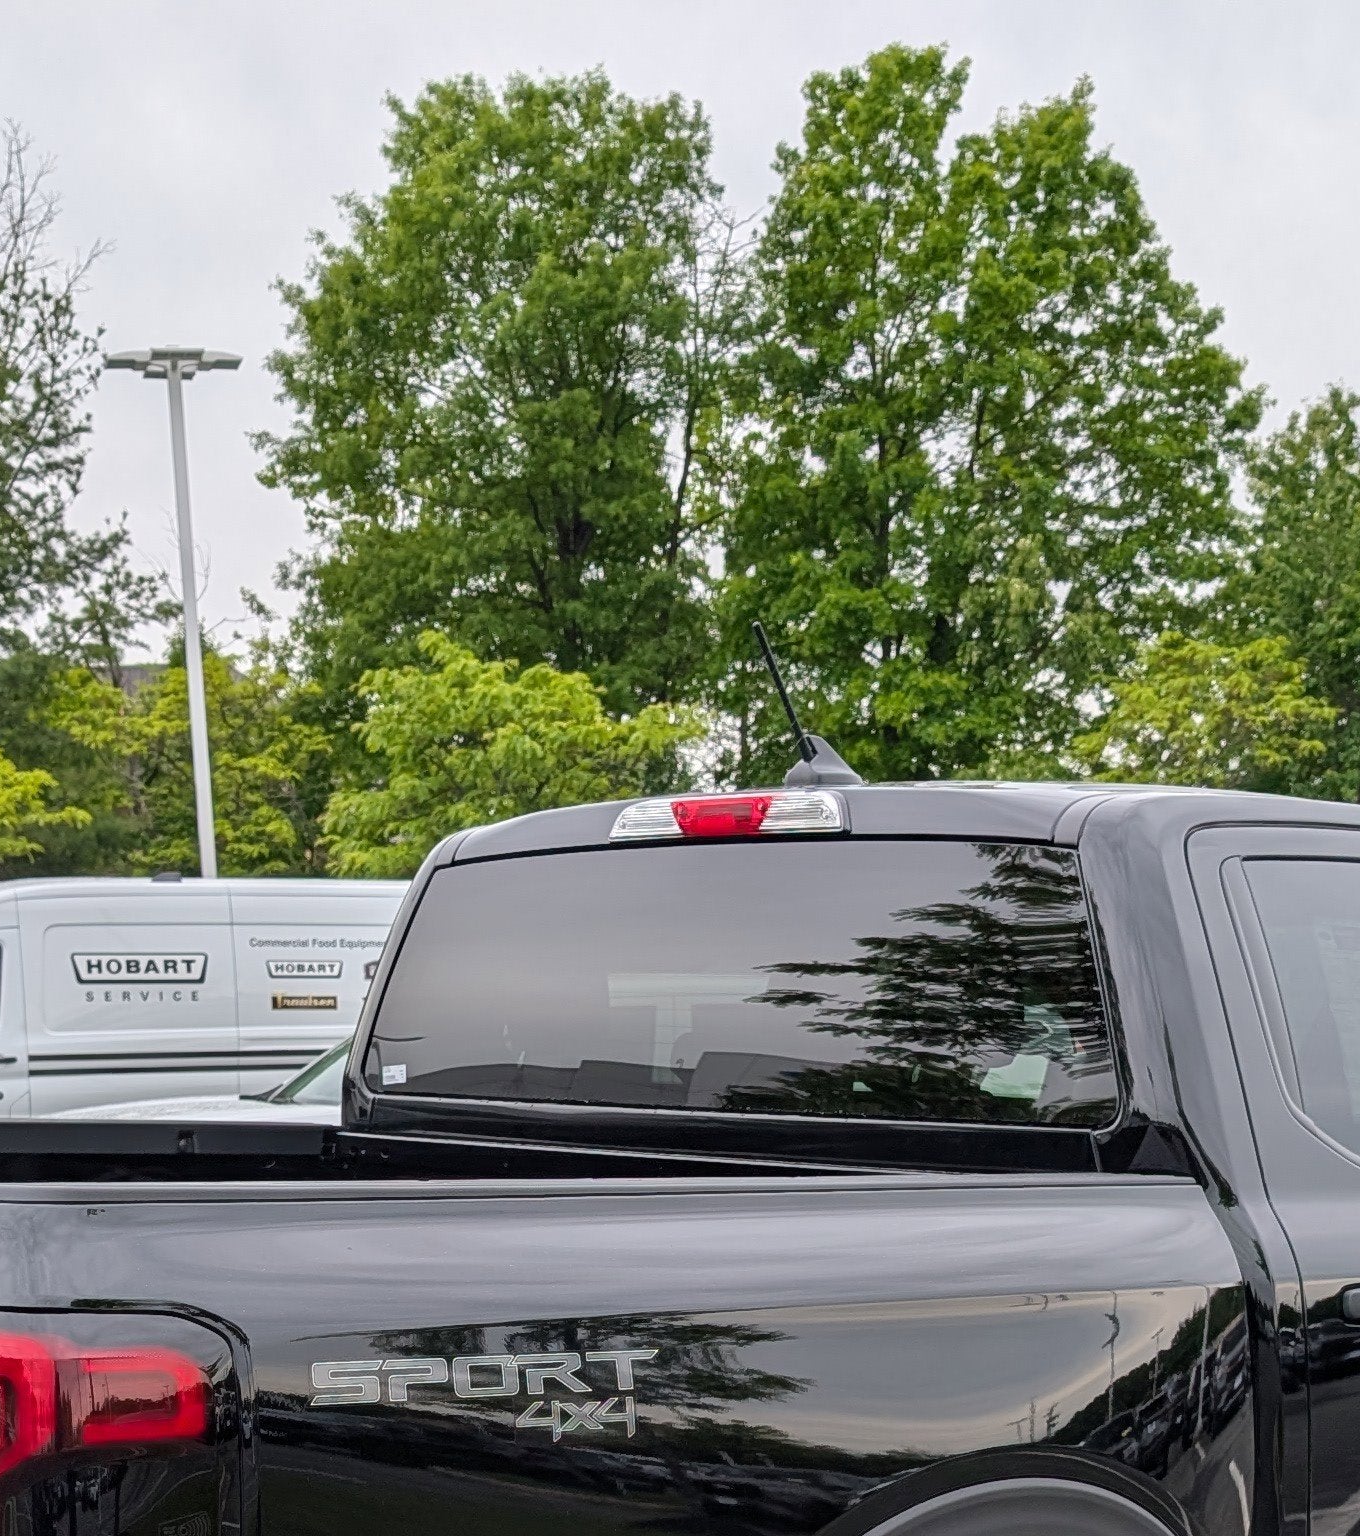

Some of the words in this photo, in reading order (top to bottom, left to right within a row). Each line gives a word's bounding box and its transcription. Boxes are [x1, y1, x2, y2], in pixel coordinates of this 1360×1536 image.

[86, 958, 196, 975] HOBART
[274, 963, 336, 974] HOBART
[85, 990, 200, 1002] SERVICE
[310, 1349, 660, 1406] SPORT
